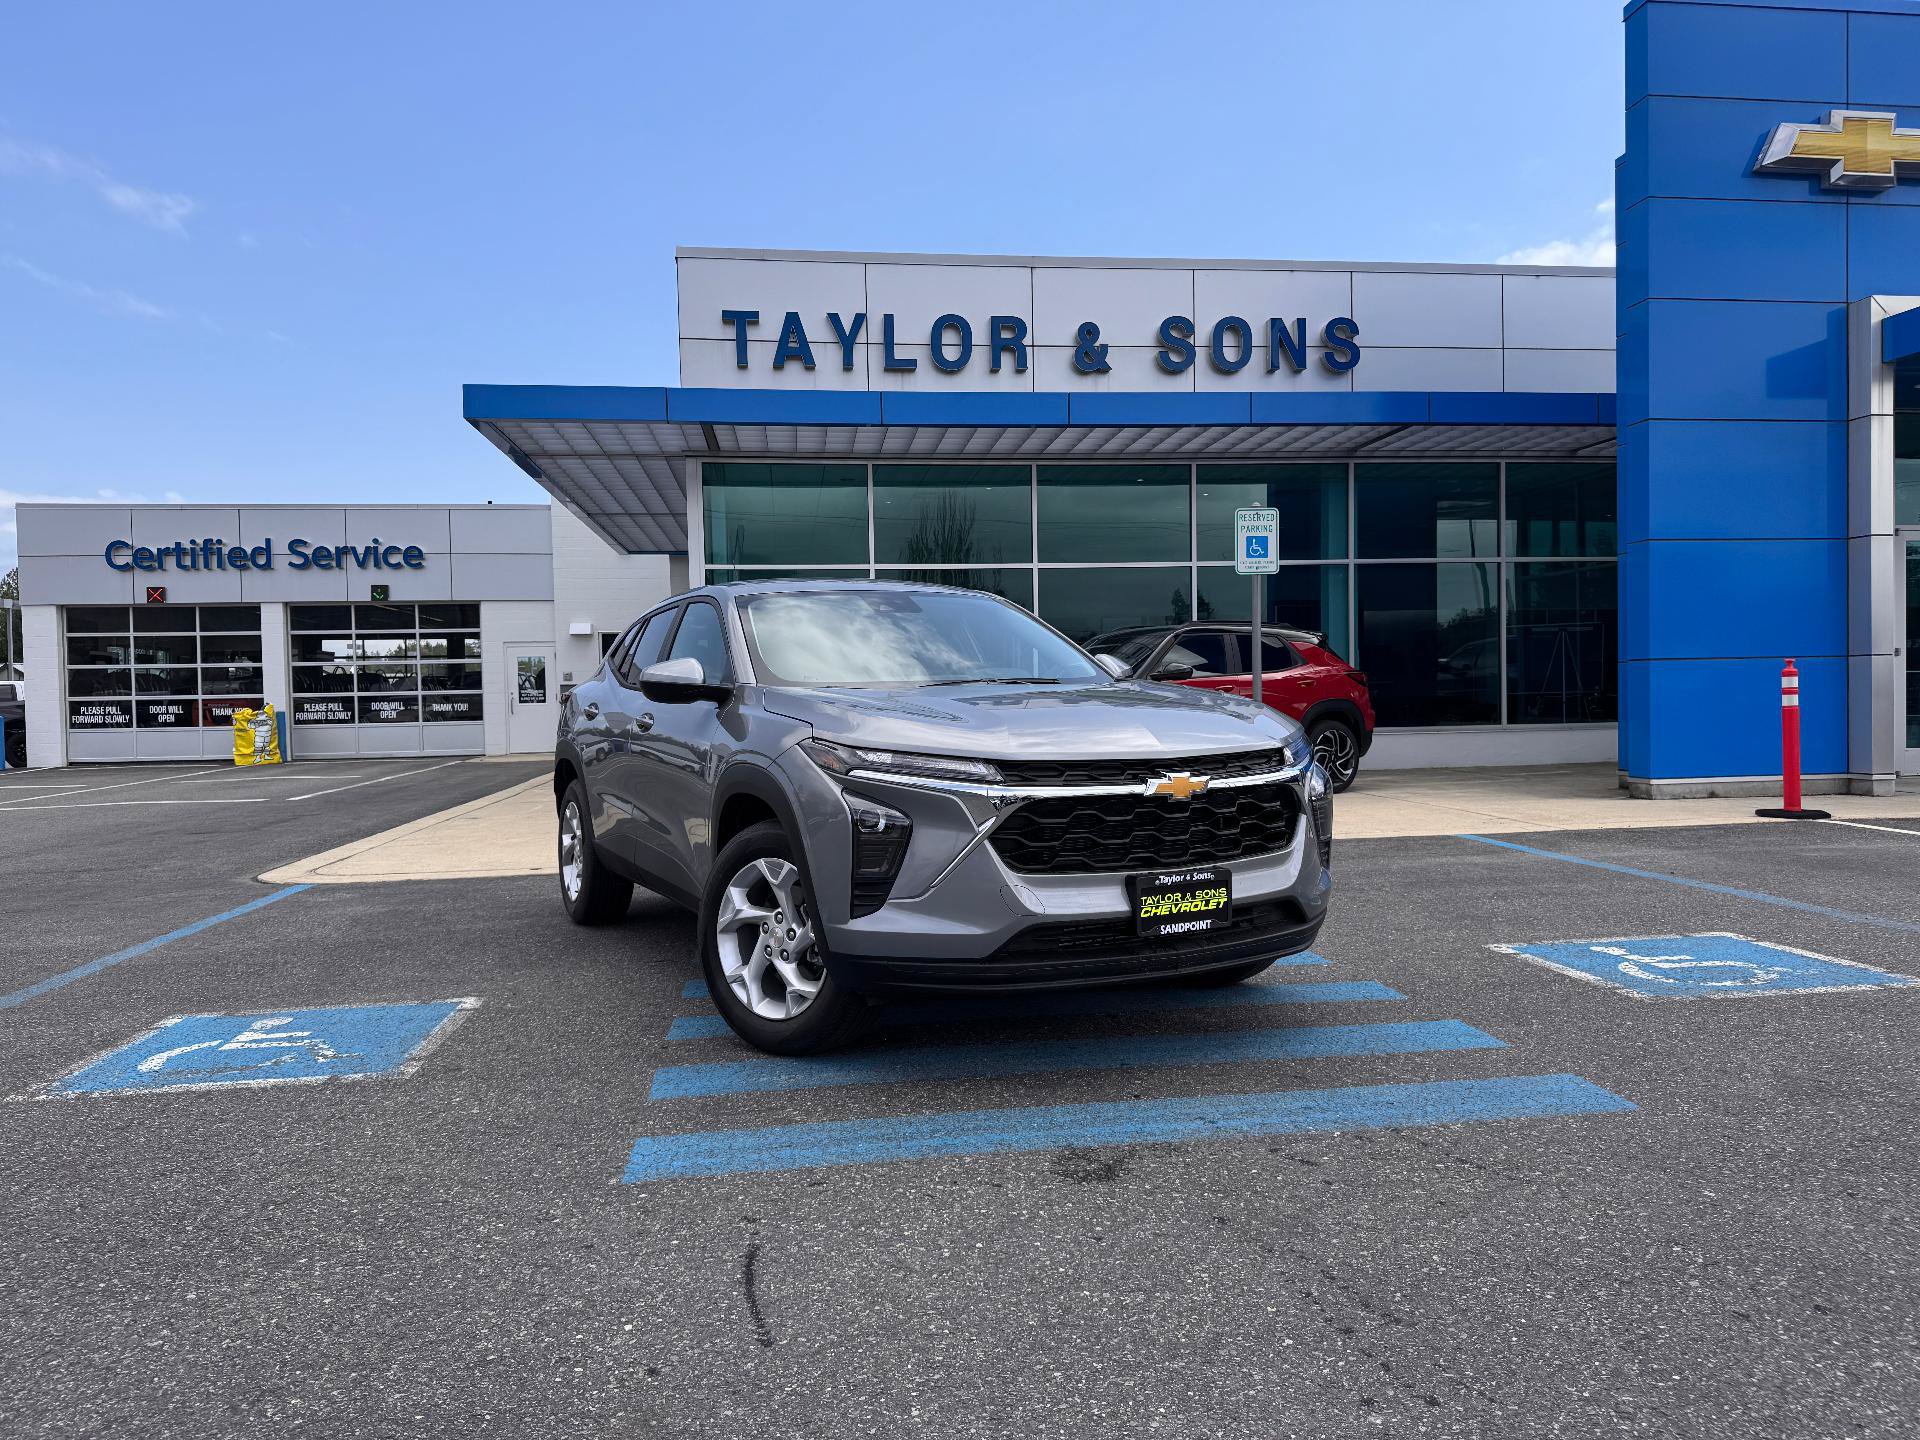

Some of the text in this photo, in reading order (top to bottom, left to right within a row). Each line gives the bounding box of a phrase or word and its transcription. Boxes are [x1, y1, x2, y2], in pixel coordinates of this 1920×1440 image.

[722, 310, 1361, 374] TAYLOR & SONS
[1239, 513, 1275, 522] RESERVED
[1240, 524, 1273, 533] PARKING
[105, 538, 425, 571] Certified Service
[80, 706, 122, 715] PLEASE PULL
[150, 705, 184, 714] DOOR WILL
[304, 703, 344, 712] PLEASE PULL
[371, 702, 404, 710] DOOR WILL
[432, 703, 469, 712] THANK YOU!
[212, 707, 233, 716] THANK
[295, 711, 352, 721] FORWARD SLOWLY
[380, 710, 397, 719] OPEN
[72, 714, 130, 724] FORWARD SLOWLY
[158, 714, 175, 723] OPEN
[1159, 874, 1184, 885] Taylor
[1192, 872, 1212, 880] Sons
[1140, 888, 1226, 906] TAYLOR & SONS
[1140, 898, 1228, 918] CHEVROLET
[1160, 920, 1212, 934] SANDPOINT
